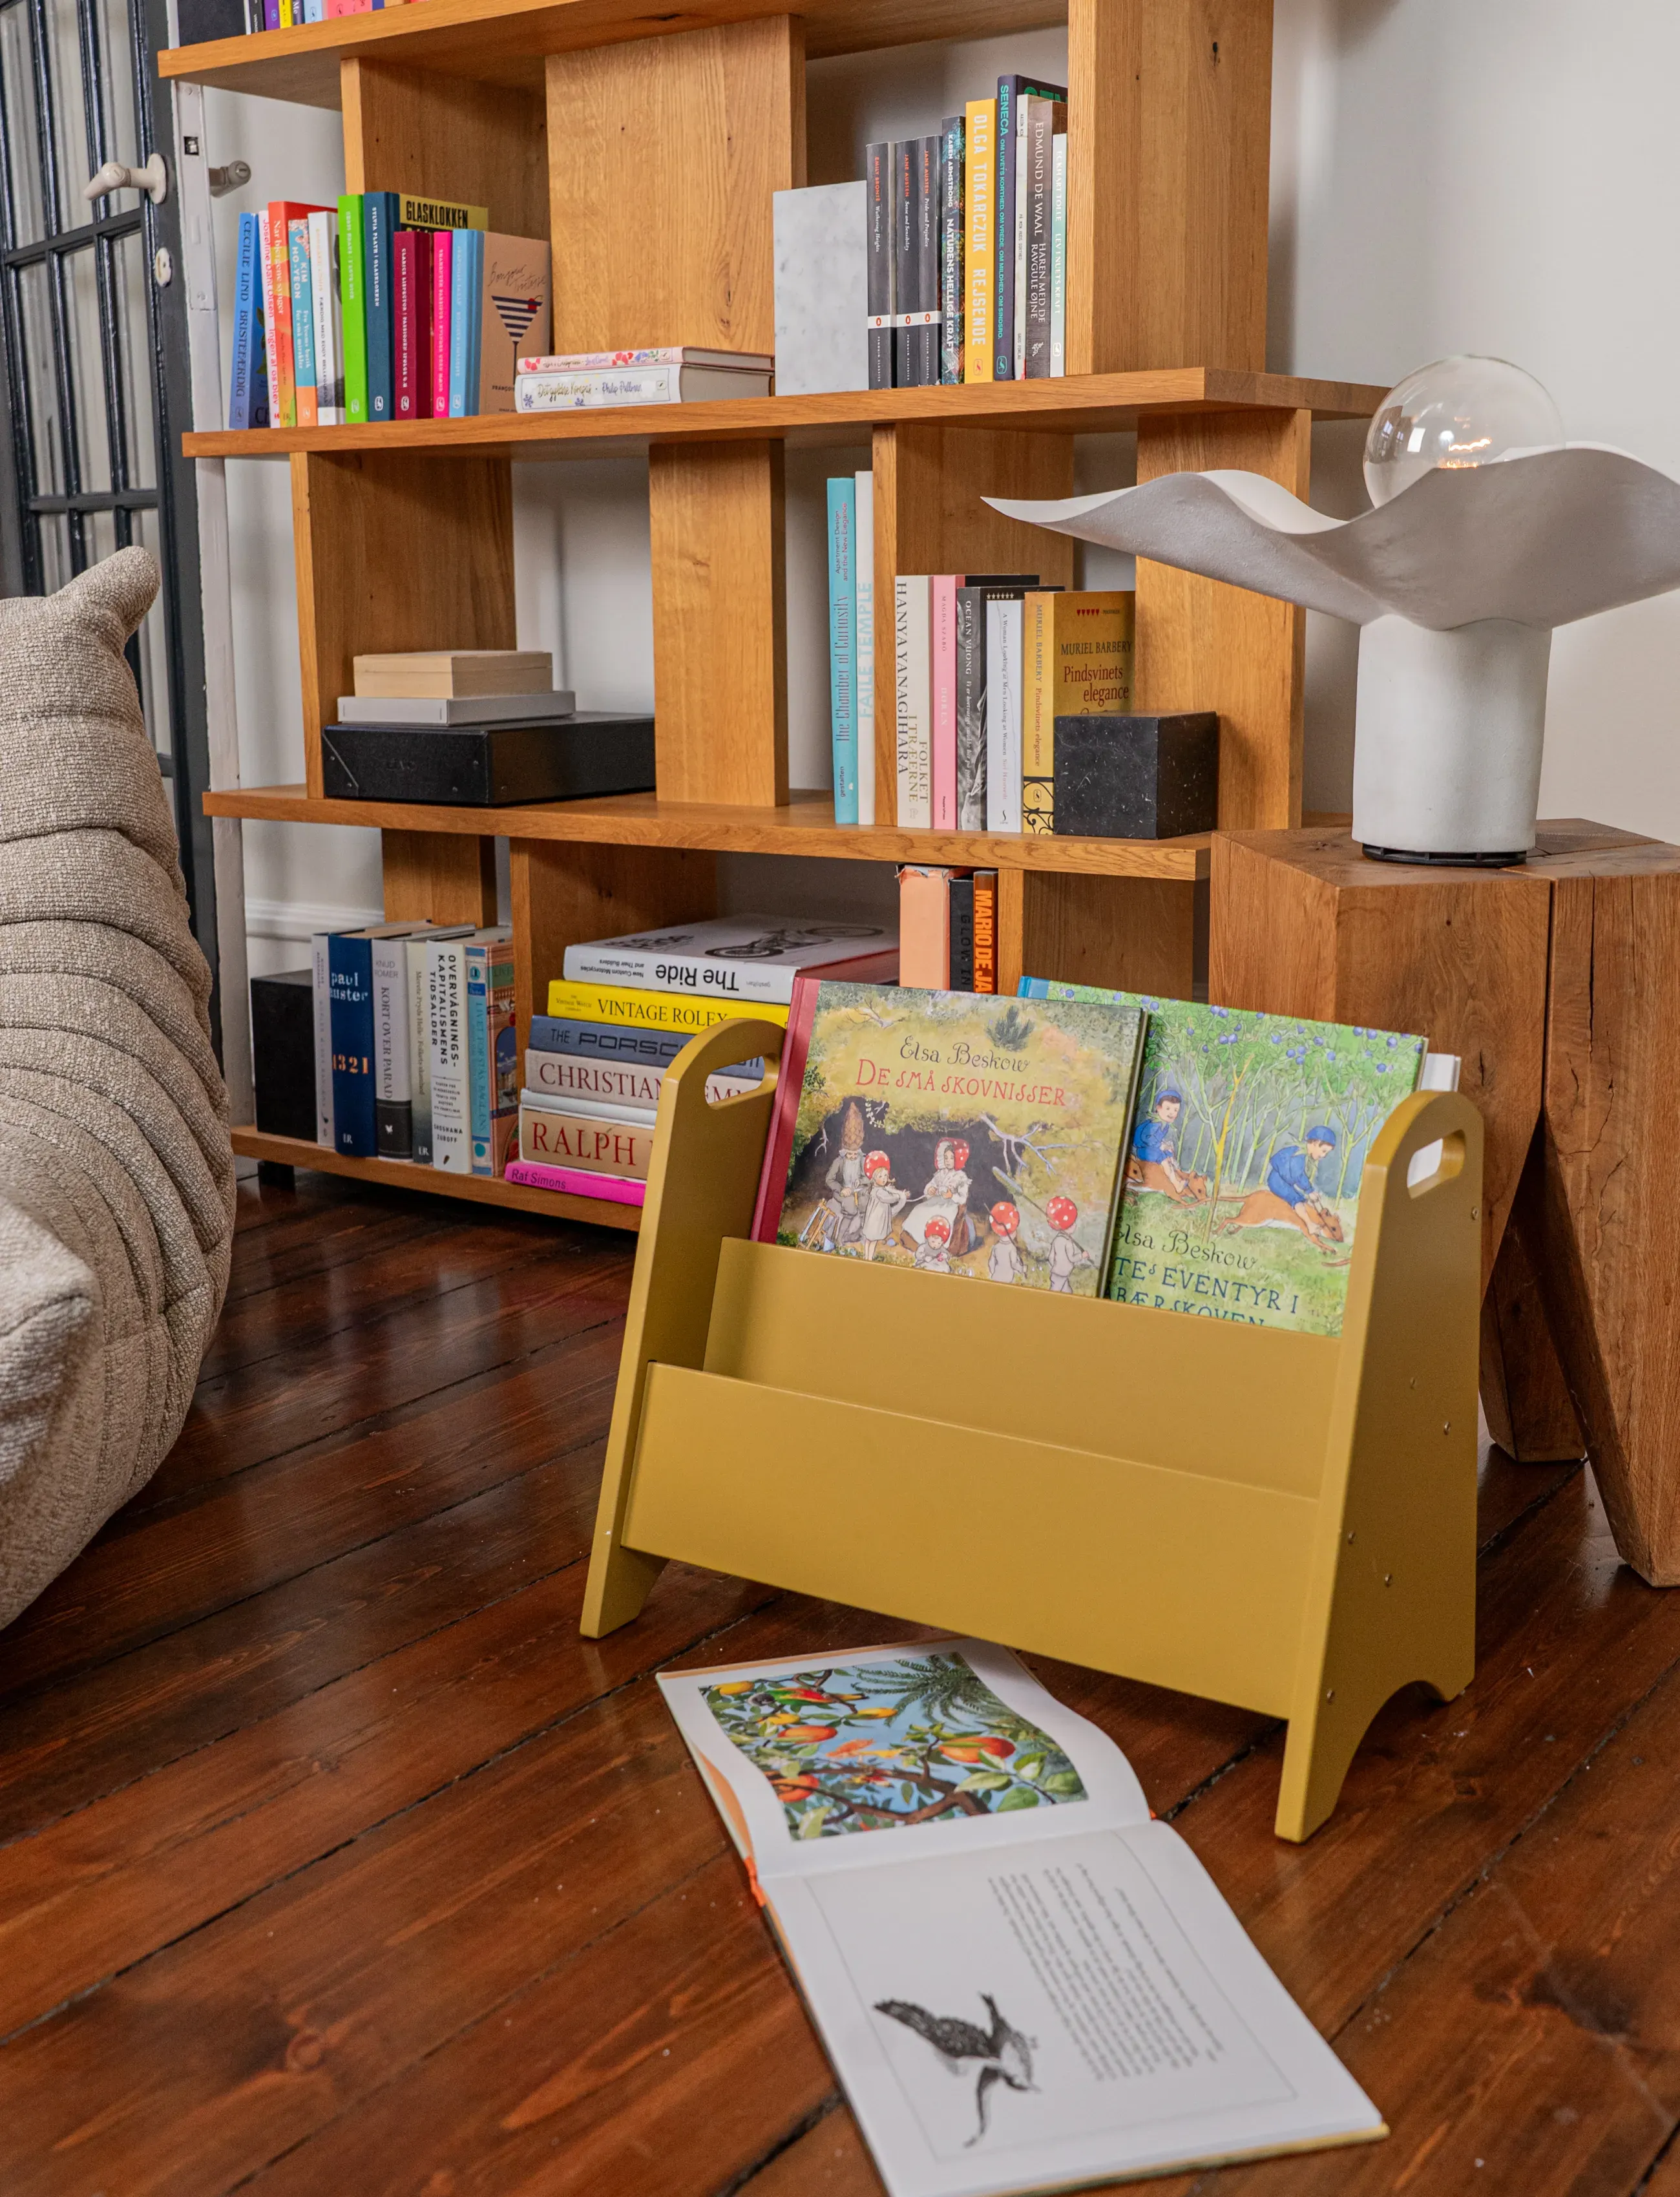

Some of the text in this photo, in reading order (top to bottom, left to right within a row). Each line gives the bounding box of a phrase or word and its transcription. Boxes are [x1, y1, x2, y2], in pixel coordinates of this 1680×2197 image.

[1000, 85, 1009, 136] SENECA
[1000, 138, 1005, 151] OM
[1034, 121, 1044, 237] EDMUND DE WAAL
[406, 200, 468, 229] GLASKLOKKEN
[972, 114, 987, 346] OLGA TOKARCZUK REJSENDE
[998, 212, 1004, 224] OM
[946, 218, 954, 274] NATURENS
[998, 250, 1004, 262] OM
[276, 282, 285, 315] synger
[946, 275, 954, 319] HELLIGE
[1029, 244, 1038, 319] RAVGULE ØJNE
[236, 221, 251, 397] CECILIE LIND BRISTEFÆRDIG
[998, 295, 1003, 307] OM
[1038, 309, 1045, 324] DE
[946, 320, 954, 353] KRAFT
[271, 370, 277, 382] os
[834, 595, 849, 649] Curiosity
[834, 653, 849, 664] of
[857, 582, 872, 719] FAILE TEMPLE
[1060, 640, 1132, 655] MURIEL BARBERY
[896, 582, 908, 775] HANYA YANAGIHARA
[1064, 663, 1124, 683] Pindsvinets
[835, 670, 850, 719] Chamber
[1082, 682, 1129, 707] elegance
[835, 723, 850, 742] The
[908, 723, 918, 803] TRÆERNE
[1033, 733, 1042, 767] elegance
[918, 741, 929, 803] FOLKET
[975, 890, 992, 946] MARIO
[599, 959, 620, 967] Builders
[960, 914, 972, 985] GLOW IN
[975, 947, 992, 970] DE
[331, 972, 359, 987] paul
[580, 965, 611, 974] Motorcycles
[655, 964, 739, 992] The Ride
[381, 986, 391, 1020] KORT
[429, 971, 438, 1046] TIDSALDER
[437, 954, 448, 1066] KAPITALISMENS
[598, 998, 668, 1023] VINTAGE
[383, 1022, 392, 1055] OVER
[551, 1028, 571, 1045] THE
[900, 1035, 1031, 1073] Elsa Beskow
[856, 1058, 1066, 1106] DE SMÅ SKOVNISSER
[532, 1121, 636, 1166] RALPH
[511, 1168, 567, 1190] Raf Simons
[1162, 1230, 1258, 1270] Beskow
[1162, 1267, 1281, 1311] EVENTYR
[1290, 1295, 1299, 1314] I
